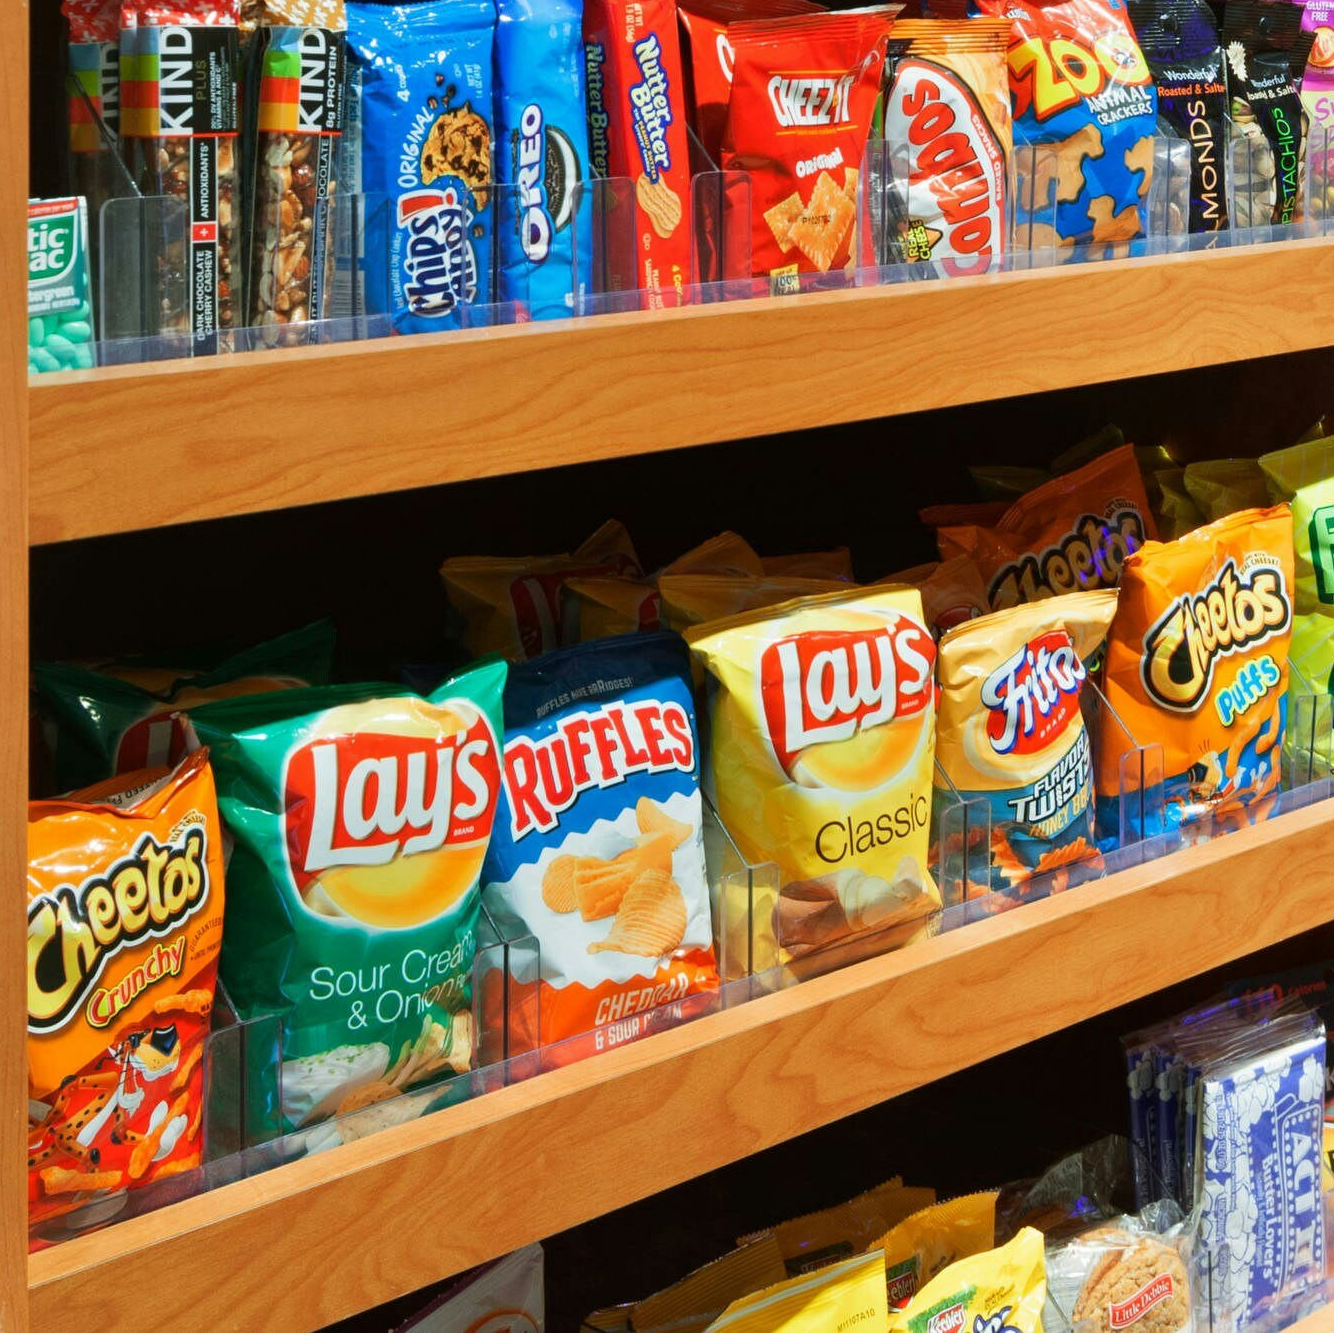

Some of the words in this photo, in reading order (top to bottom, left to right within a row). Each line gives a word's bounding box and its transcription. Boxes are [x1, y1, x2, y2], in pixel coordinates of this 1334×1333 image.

[1306, 0, 1334, 13] GLUTEN
[1311, 10, 1329, 23] FREE
[160, 27, 193, 136] KIND
[196, 59, 207, 100] PLUS
[298, 27, 328, 136] KIND
[326, 45, 337, 111] PROTEIN
[397, 89, 410, 103] 4
[586, 44, 604, 112] Nutter
[635, 37, 672, 125] Nutter
[1007, 35, 1153, 124] ZOO
[1085, 85, 1152, 113] ANIMAL
[1157, 84, 1195, 98] Roasted
[1195, 84, 1203, 96] &
[1203, 82, 1226, 95] Salte
[1163, 65, 1218, 83] Wonderful
[326, 111, 335, 129] 8g
[592, 112, 609, 178] Butter
[632, 86, 669, 167] Butter
[971, 113, 997, 160] SNACKS
[1096, 100, 1154, 126] CRACKERS
[398, 106, 435, 189] ORIGINAL
[902, 78, 992, 277] Combos
[1273, 106, 1297, 226] PISTACHIOS
[199, 141, 209, 219] ANTIOXIDANTS
[518, 103, 554, 265] OREO
[994, 161, 1003, 201] BAKED
[28, 247, 66, 272] ac
[205, 249, 213, 293] CASHEW
[908, 223, 919, 258] REAL
[196, 249, 205, 310] CHOCOLATE
[197, 311, 206, 342] DARK
[205, 293, 213, 336] CHERRY
[1147, 567, 1288, 709] Cheetos
[782, 624, 933, 752] Lay's
[901, 699, 920, 710] BRAND
[981, 640, 1087, 753] Fritos
[1216, 656, 1282, 728] Puffs
[1039, 707, 1066, 739] BRAND
[504, 702, 695, 842] RUFFLES
[1034, 731, 1085, 799] FLAVOR
[305, 731, 490, 873] Lay's
[453, 825, 475, 837] BRAND
[815, 793, 928, 863] Classic
[28, 837, 200, 1006] Cheetos
[87, 935, 187, 1028] Crunchy
[310, 960, 388, 1003] Sour
[402, 930, 473, 983] Cream
[347, 1001, 367, 1030] &
[378, 977, 455, 1024] Onion
[594, 972, 689, 1026] CHEDDAR
[595, 1030, 605, 1050] &
[608, 1017, 641, 1045] SOUR
[1261, 1152, 1276, 1217] Butter
[1290, 1131, 1316, 1216] ACT
[1261, 1216, 1281, 1280] Lovers
[886, 1272, 916, 1303] eebler
[928, 1306, 966, 1333] Keebler
[1114, 1297, 1140, 1324] Little
[1140, 1277, 1172, 1309] Debbie
